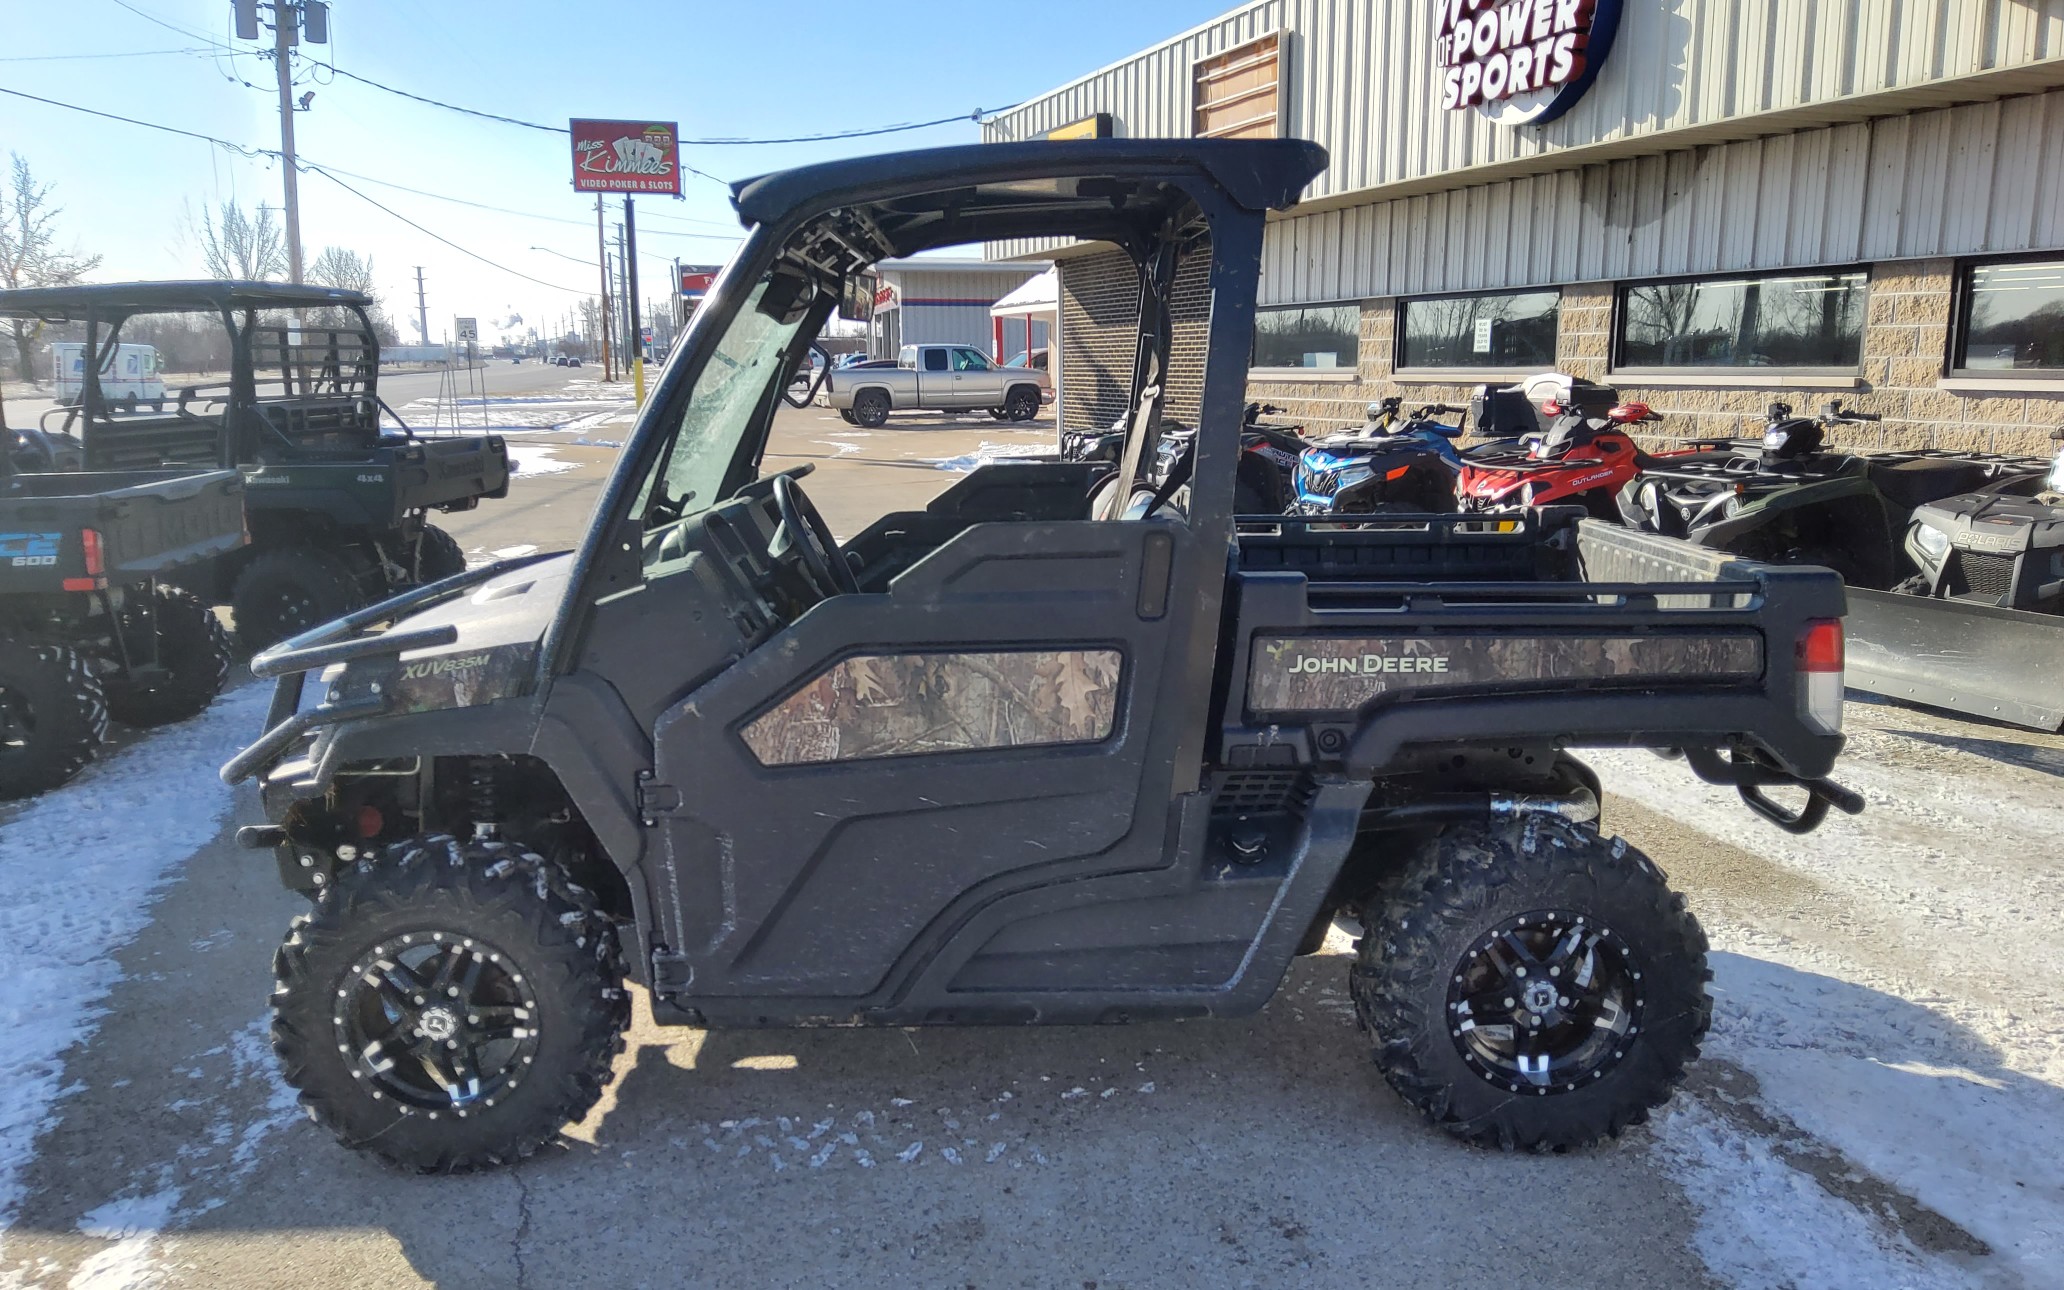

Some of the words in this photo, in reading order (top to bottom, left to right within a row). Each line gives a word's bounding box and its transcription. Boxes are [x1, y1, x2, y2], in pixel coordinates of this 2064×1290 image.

[1437, 36, 1453, 67] OF
[1452, 0, 1582, 64] POWER
[1441, 32, 1577, 110] SPORTS
[576, 139, 605, 152] Miss
[579, 149, 674, 176] Kimmees
[580, 178, 607, 188] VIDEO
[609, 179, 638, 189] POKER
[639, 181, 647, 189] &
[649, 180, 674, 190] SLOTS
[459, 329, 476, 339] 45
[1572, 470, 1614, 486] OUTLANDER
[1957, 532, 2022, 548] POLARIS
[11, 555, 57, 567] 600
[1288, 654, 1357, 673] JOHN
[1362, 654, 1449, 673] DEERE
